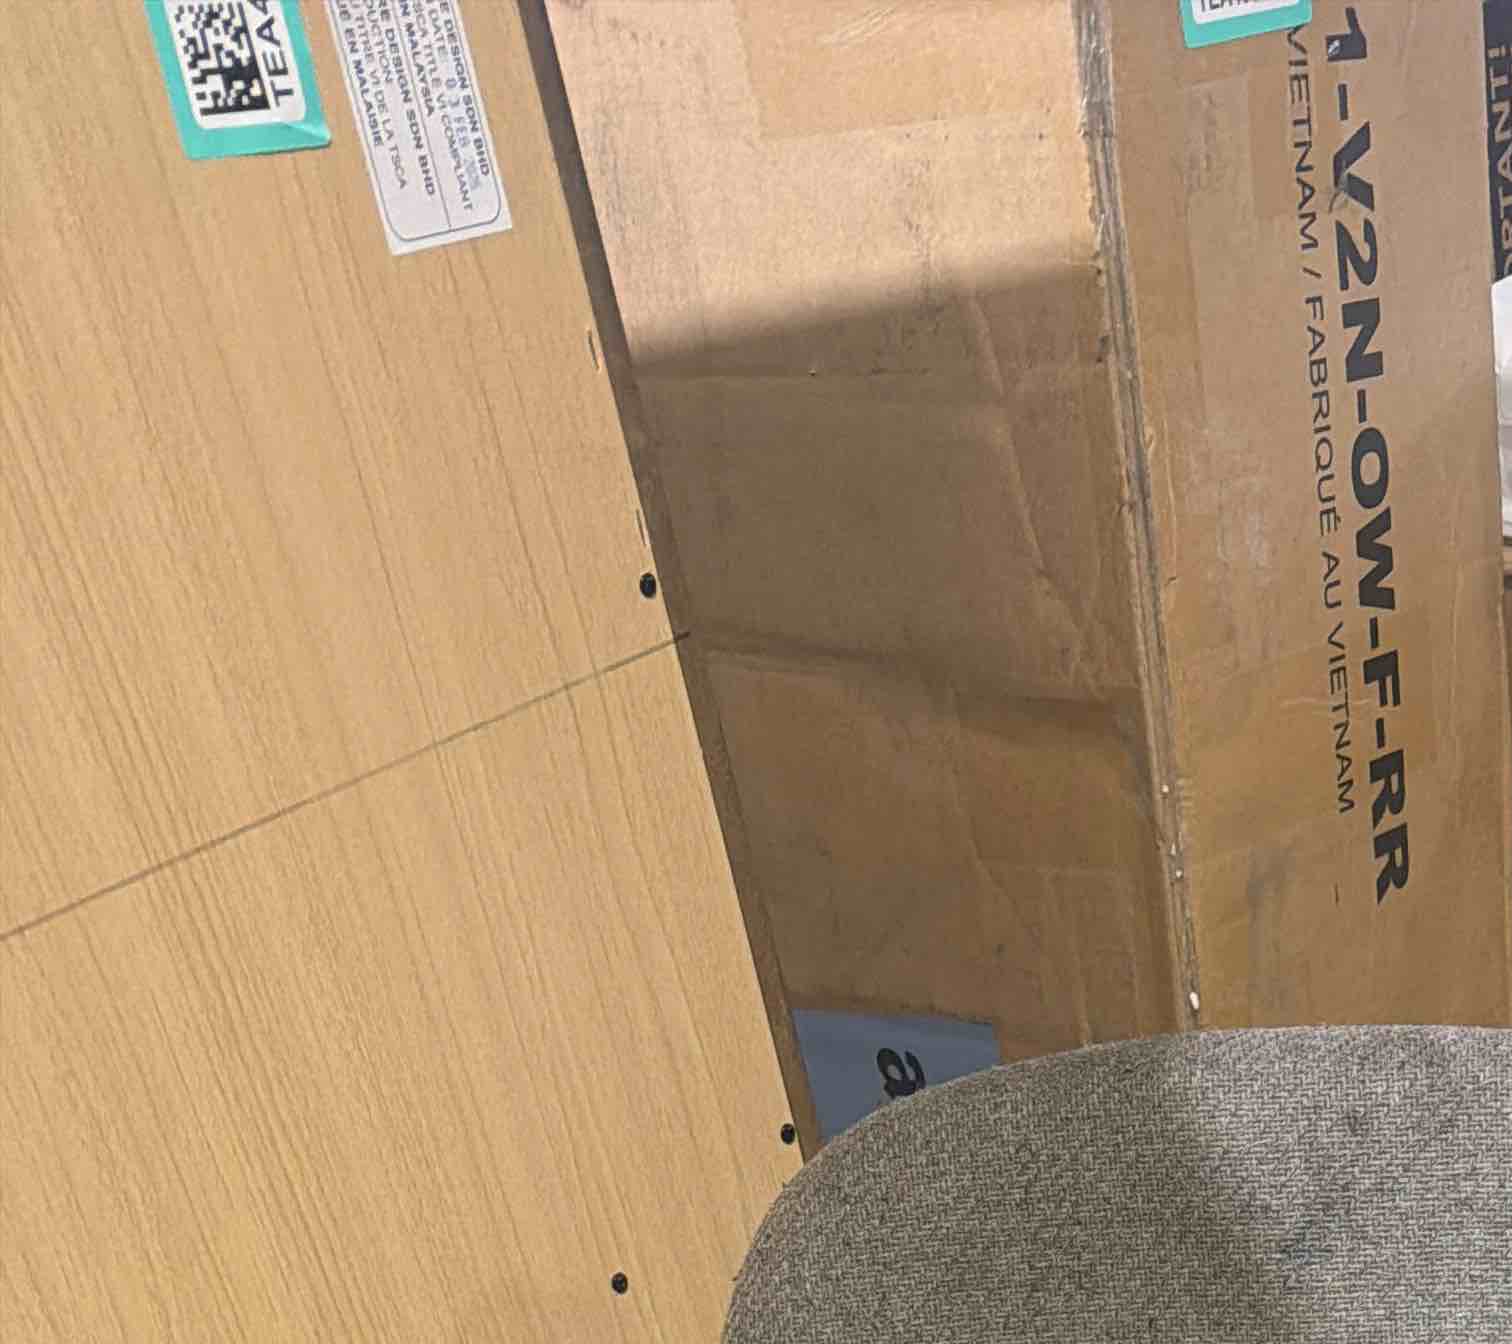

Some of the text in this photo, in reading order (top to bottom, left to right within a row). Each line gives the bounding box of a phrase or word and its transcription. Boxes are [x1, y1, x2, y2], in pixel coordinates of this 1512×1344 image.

[353, 59, 384, 148] MALAISIE
[385, 28, 413, 104] DESIGN
[406, 109, 423, 150] SDN
[418, 155, 436, 197] BHD
[405, 22, 435, 118] MALAYSIA
[444, 19, 470, 90] DESIGN
[1287, 24, 1319, 251] VIETNAM
[1305, 295, 1342, 537] FABRIQUÉ
[1322, 551, 1342, 609] AU
[1327, 621, 1355, 814] VIETNAM
